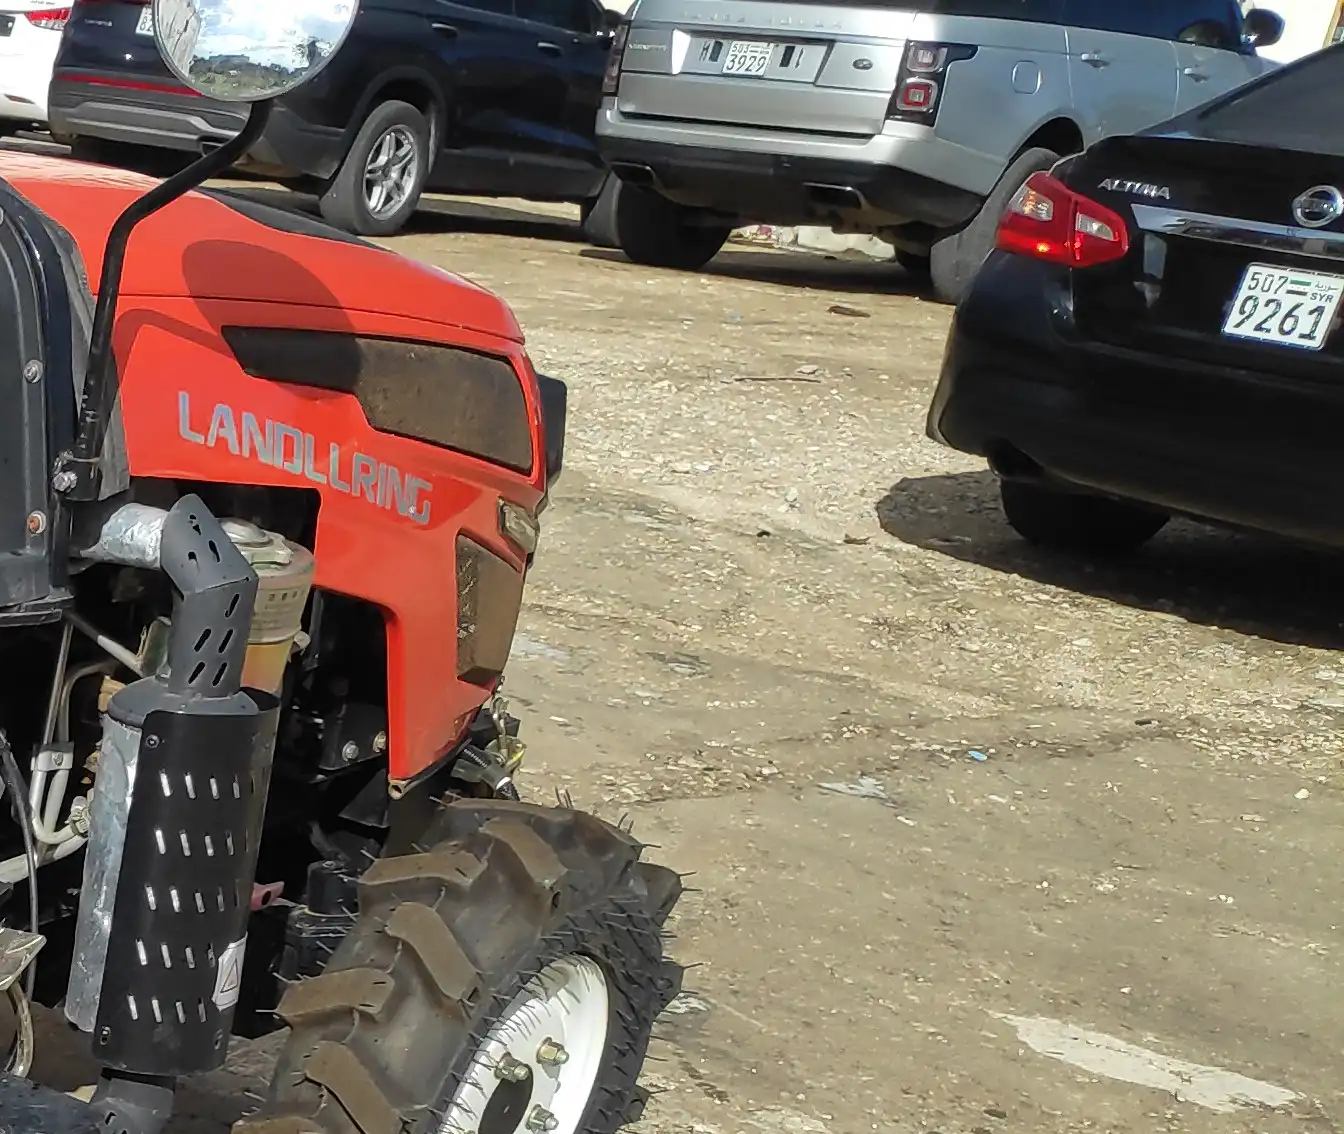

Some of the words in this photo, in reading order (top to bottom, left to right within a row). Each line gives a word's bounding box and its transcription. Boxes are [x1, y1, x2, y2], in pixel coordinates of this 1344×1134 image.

[725, 54, 768, 73] 3929
[1247, 271, 1289, 295] 507
[1309, 292, 1334, 304] SYR
[1232, 294, 1326, 341] 9261
[178, 391, 433, 525] LANDLLRING
